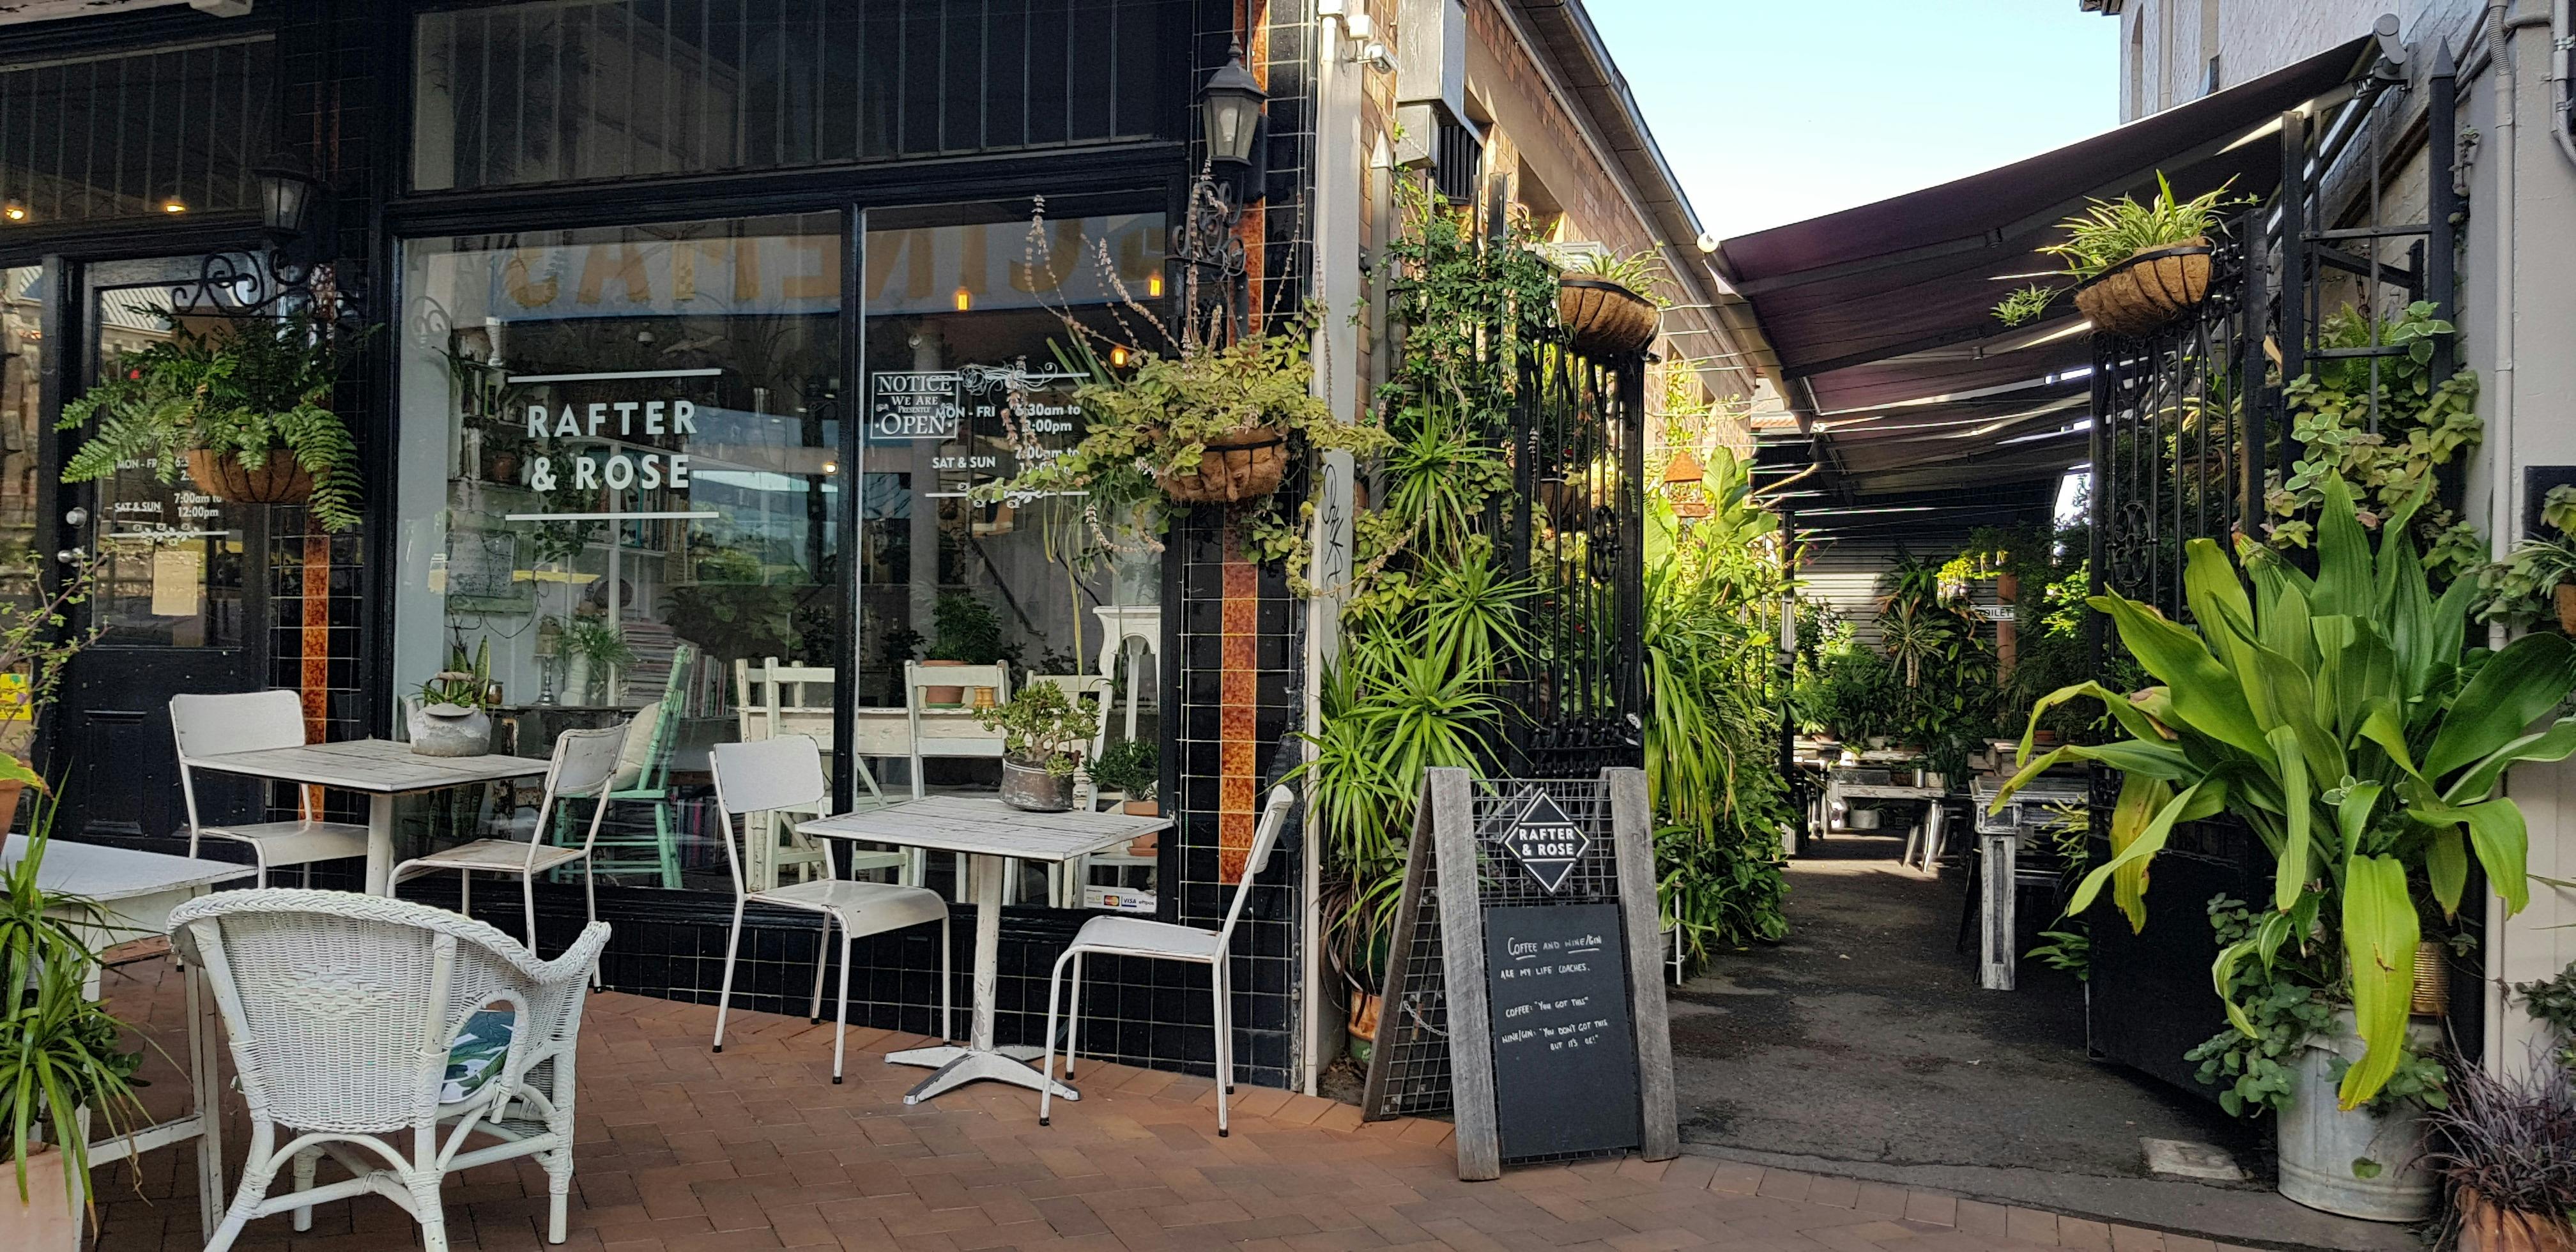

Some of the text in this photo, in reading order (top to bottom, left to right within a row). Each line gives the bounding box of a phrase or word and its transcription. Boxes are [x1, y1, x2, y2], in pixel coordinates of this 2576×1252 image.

[878, 376, 952, 392] NOTICE
[935, 407, 965, 418] MON
[977, 406, 995, 417] FRI
[1068, 404, 1081, 415] to
[528, 401, 697, 438] RAFTER
[880, 413, 945, 435] OPEN
[117, 459, 139, 468] MON
[932, 457, 996, 469] SAT & SUN
[531, 454, 689, 491] & ROSE
[174, 492, 210, 503] 7:00am
[115, 501, 161, 512] SAT & SUN
[178, 507, 218, 519] 12:00pm
[1519, 828, 1575, 841] RAFTER
[1522, 843, 1574, 856] & ROSE
[1543, 941, 1560, 950] AND
[1501, 963, 1590, 980] ARE MY LIFE COACHES.
[1555, 1000, 1568, 1009] GOT
[1578, 1021, 1591, 1032] GOT
[1594, 1019, 1608, 1028] THIS
[1550, 1042, 1563, 1051] BUT
